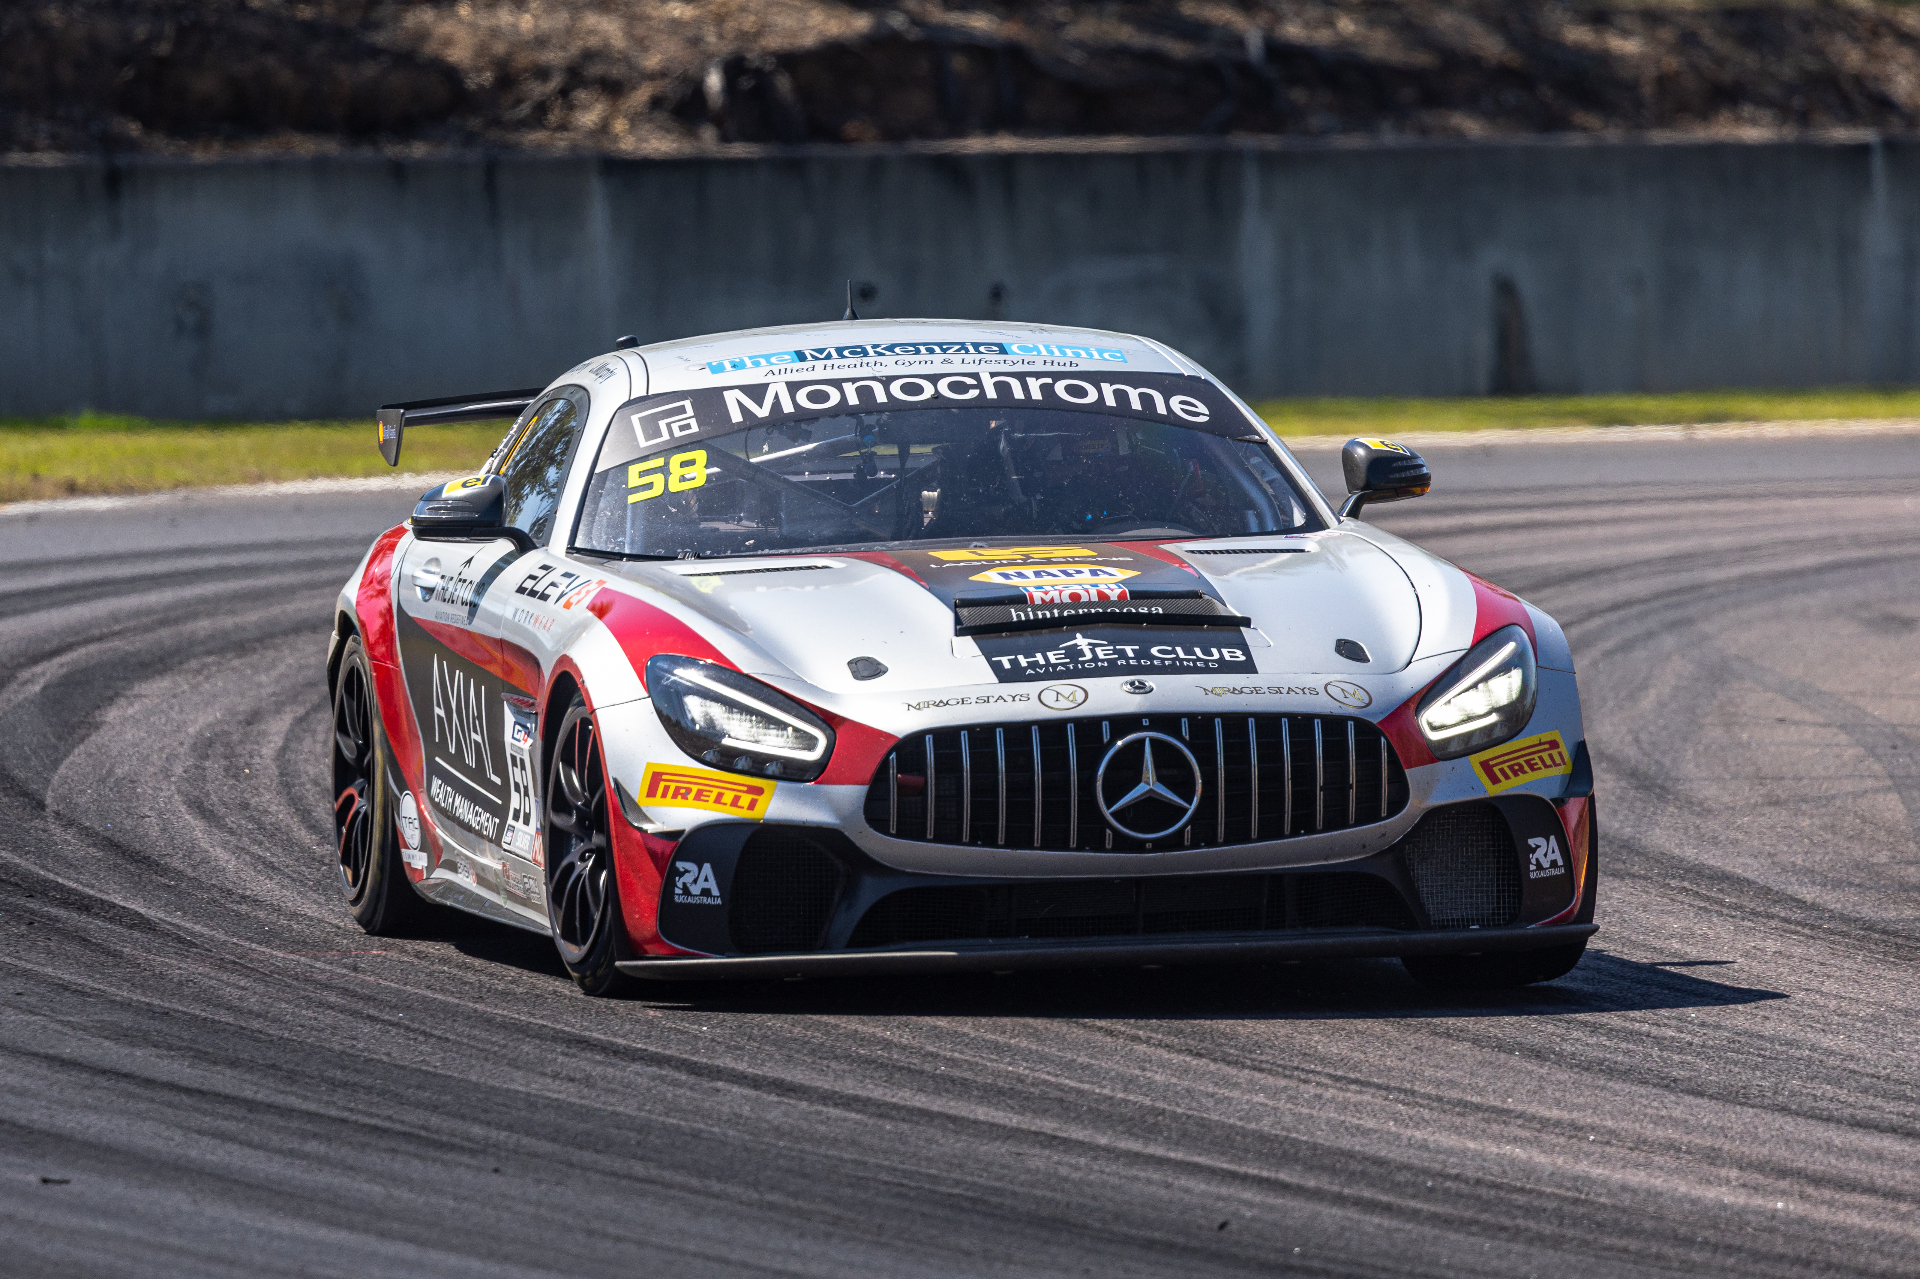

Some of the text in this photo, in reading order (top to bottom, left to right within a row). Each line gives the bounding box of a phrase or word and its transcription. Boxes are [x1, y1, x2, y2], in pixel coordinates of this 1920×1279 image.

[712, 342, 1124, 372] The McKenzie Clinic
[764, 356, 1079, 377] Allied Health, Gym & Lifestyle Hub
[722, 372, 1210, 424] Monochrome
[627, 449, 707, 504] 58
[930, 558, 1049, 568] LAGUNA
[996, 568, 1117, 581] NAPA
[1027, 583, 1121, 592] LIQUI
[1032, 589, 1123, 604] MOLY
[992, 645, 1247, 670] THE JET CLUB
[1025, 659, 1219, 675] AVIATION REDEFINED
[902, 693, 1030, 711] MIRAGE STAYS
[1195, 685, 1319, 697] MIRAGE STAYS
[433, 653, 502, 786] AXIAL
[1478, 739, 1567, 786] PIRELLI
[510, 752, 532, 828] 58
[645, 771, 765, 812] PIRELLI
[431, 775, 454, 812] WEALTH
[454, 794, 500, 839] MANAGEMENT
[1527, 835, 1564, 871] RA
[675, 861, 720, 896] RA
